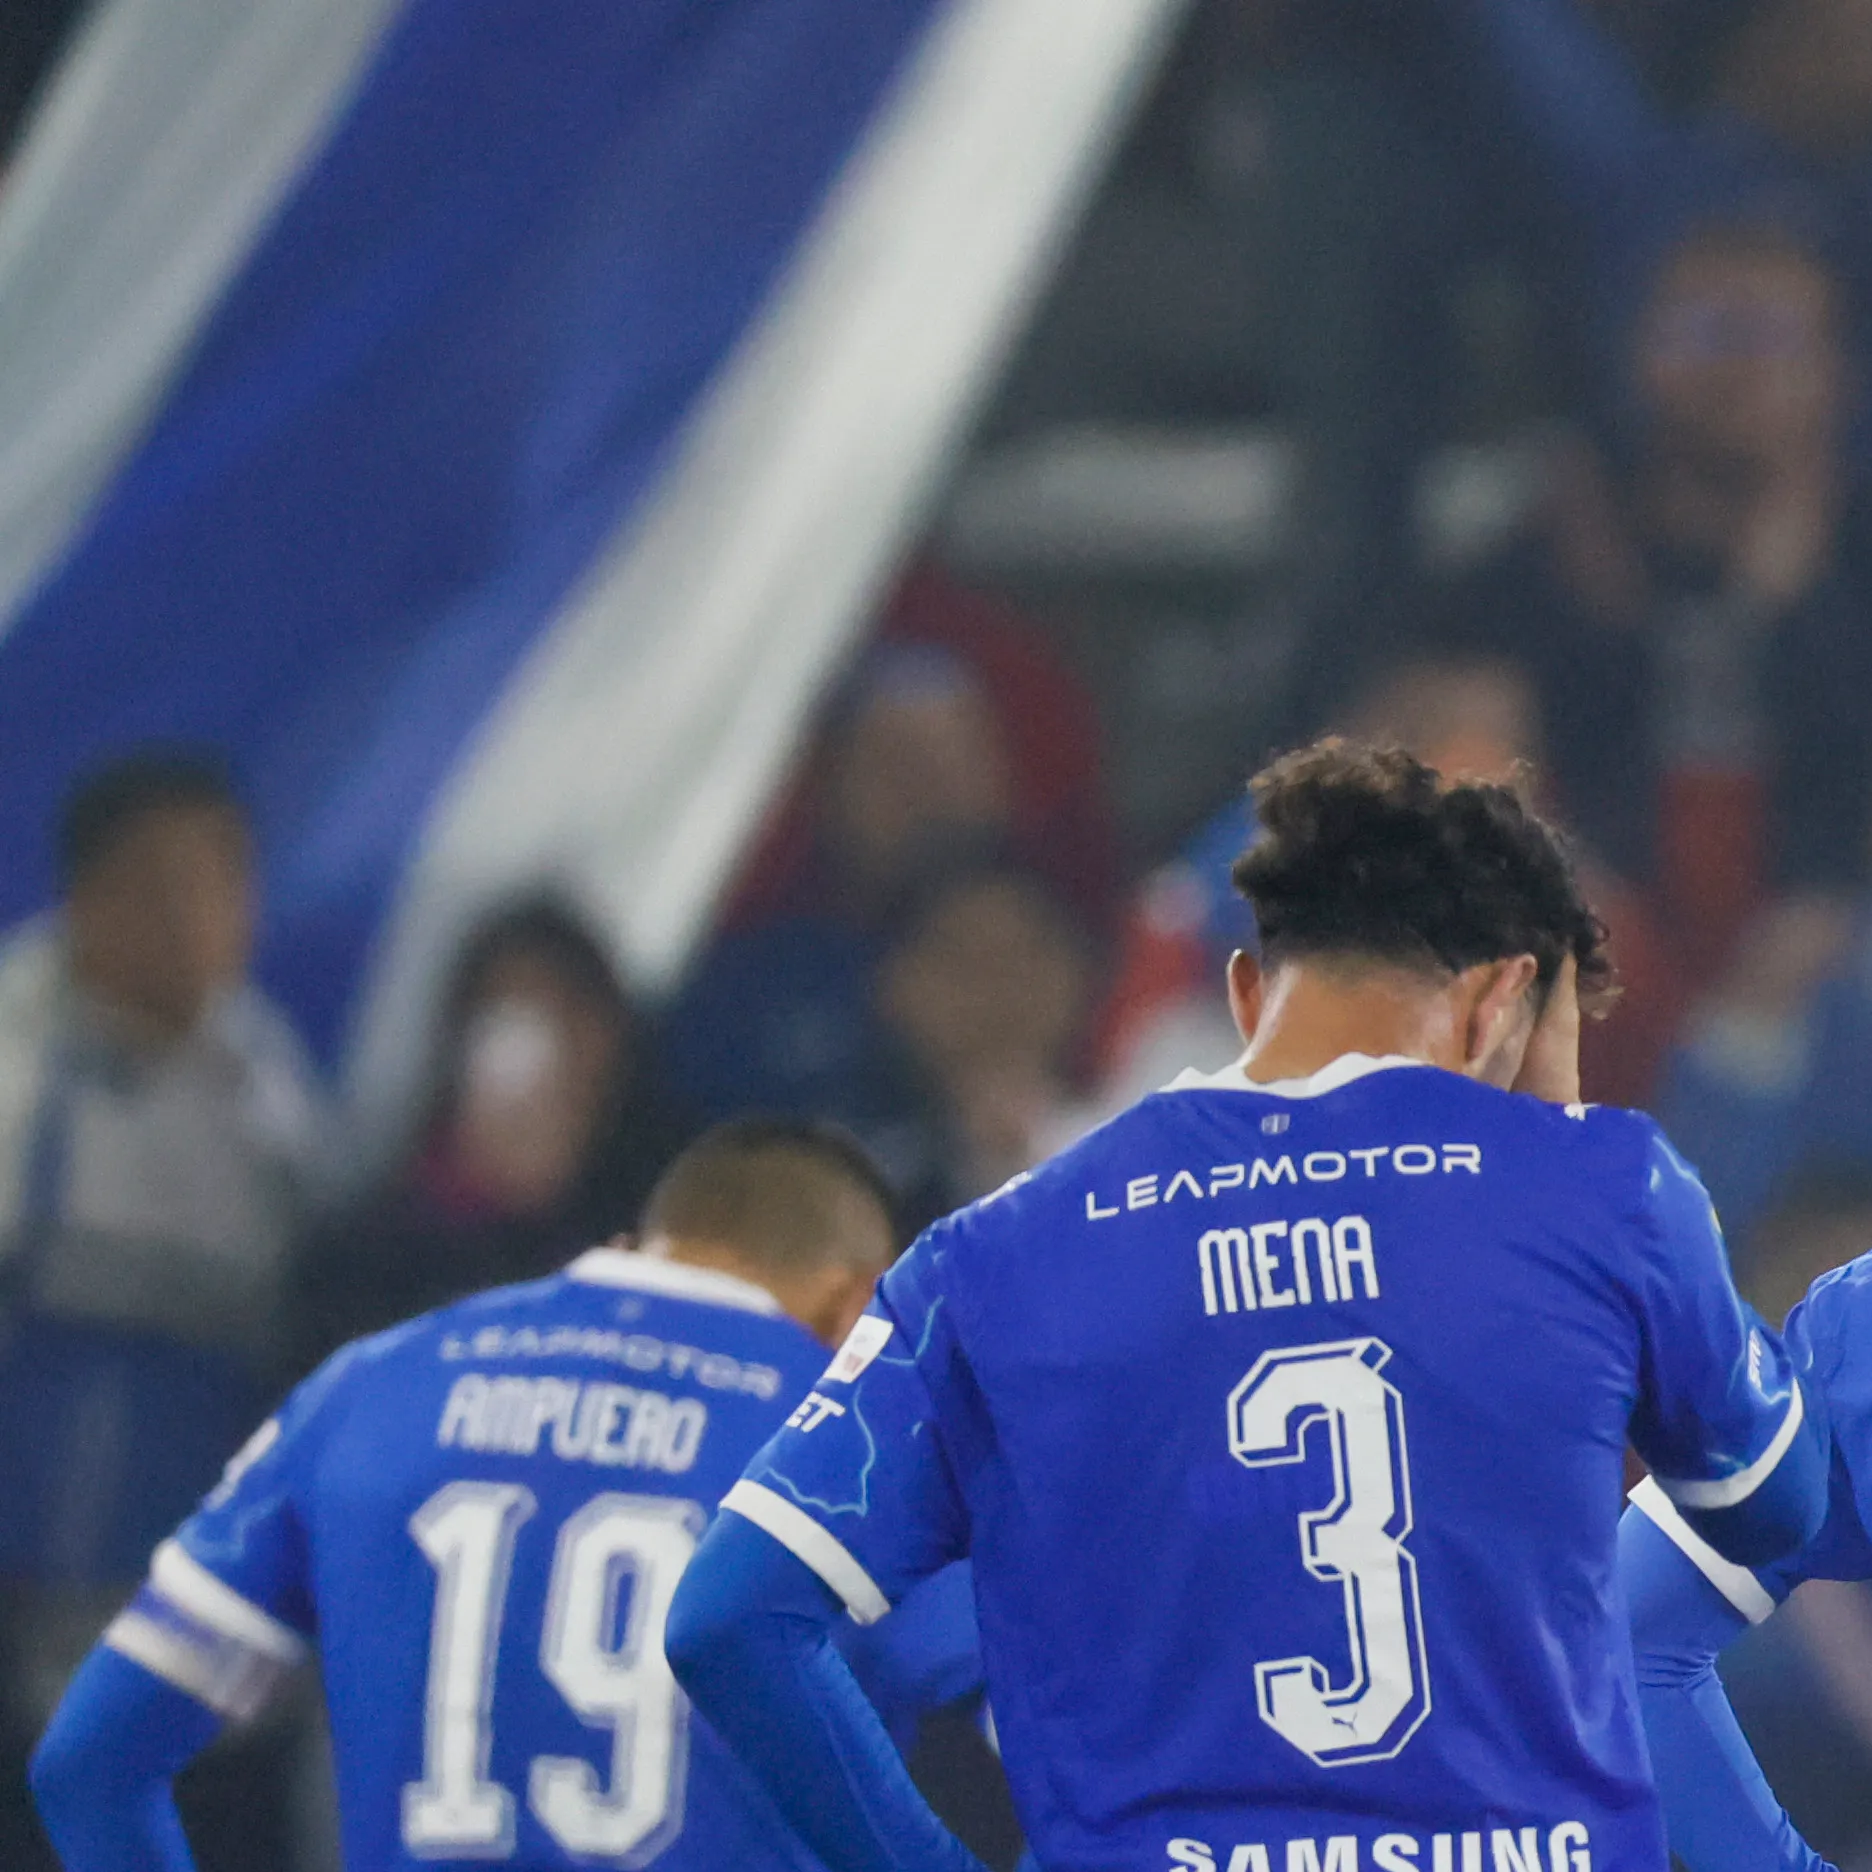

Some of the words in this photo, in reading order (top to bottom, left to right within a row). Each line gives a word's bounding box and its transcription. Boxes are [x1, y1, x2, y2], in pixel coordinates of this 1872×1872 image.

[1084, 1141, 1483, 1221] LEAPMOTOR
[1197, 1215, 1380, 1316] MENA
[436, 1373, 708, 1473] AMPUERO
[1226, 1335, 1432, 1768] 3
[400, 1478, 705, 1871] 19
